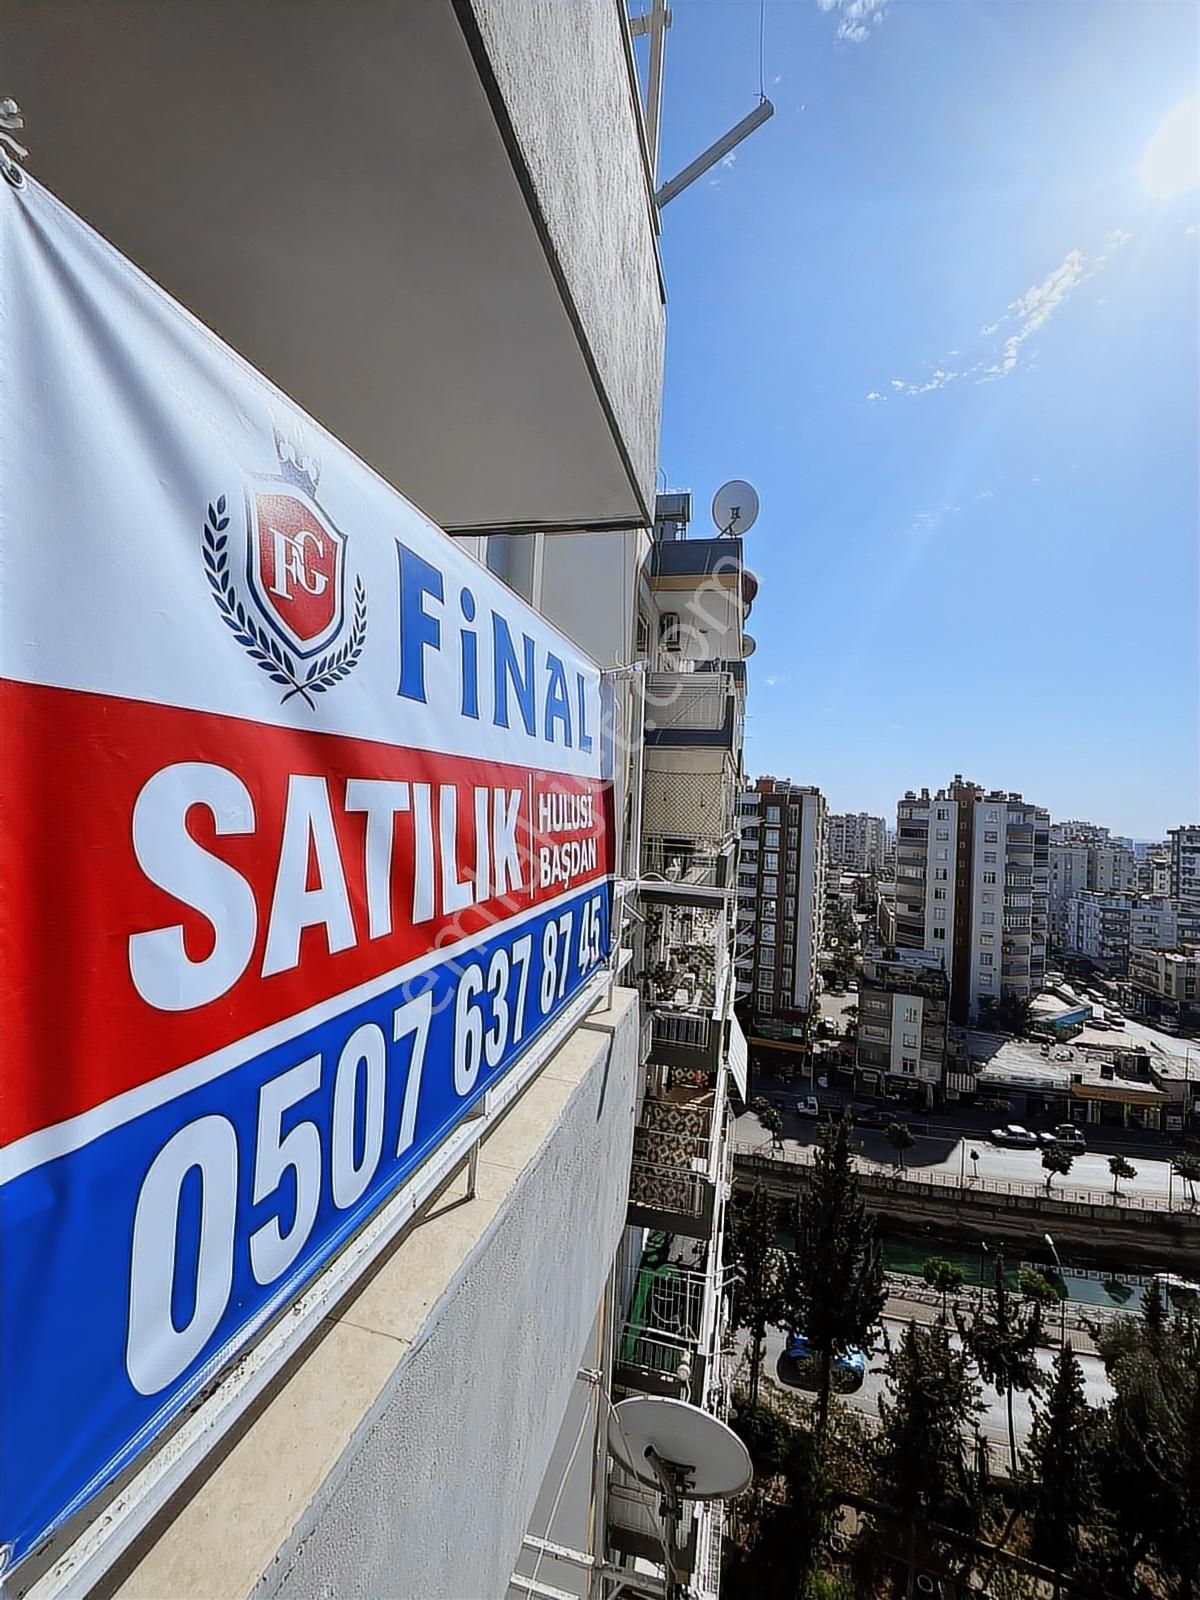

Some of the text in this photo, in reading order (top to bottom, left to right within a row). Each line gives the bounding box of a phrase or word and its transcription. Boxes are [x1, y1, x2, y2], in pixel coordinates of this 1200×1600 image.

[127, 761, 523, 1012] SATILIK
[538, 789, 594, 834] HULUSİ
[539, 837, 597, 890] BAŞDAN
[126, 894, 602, 1396] 0507 637 87 45
